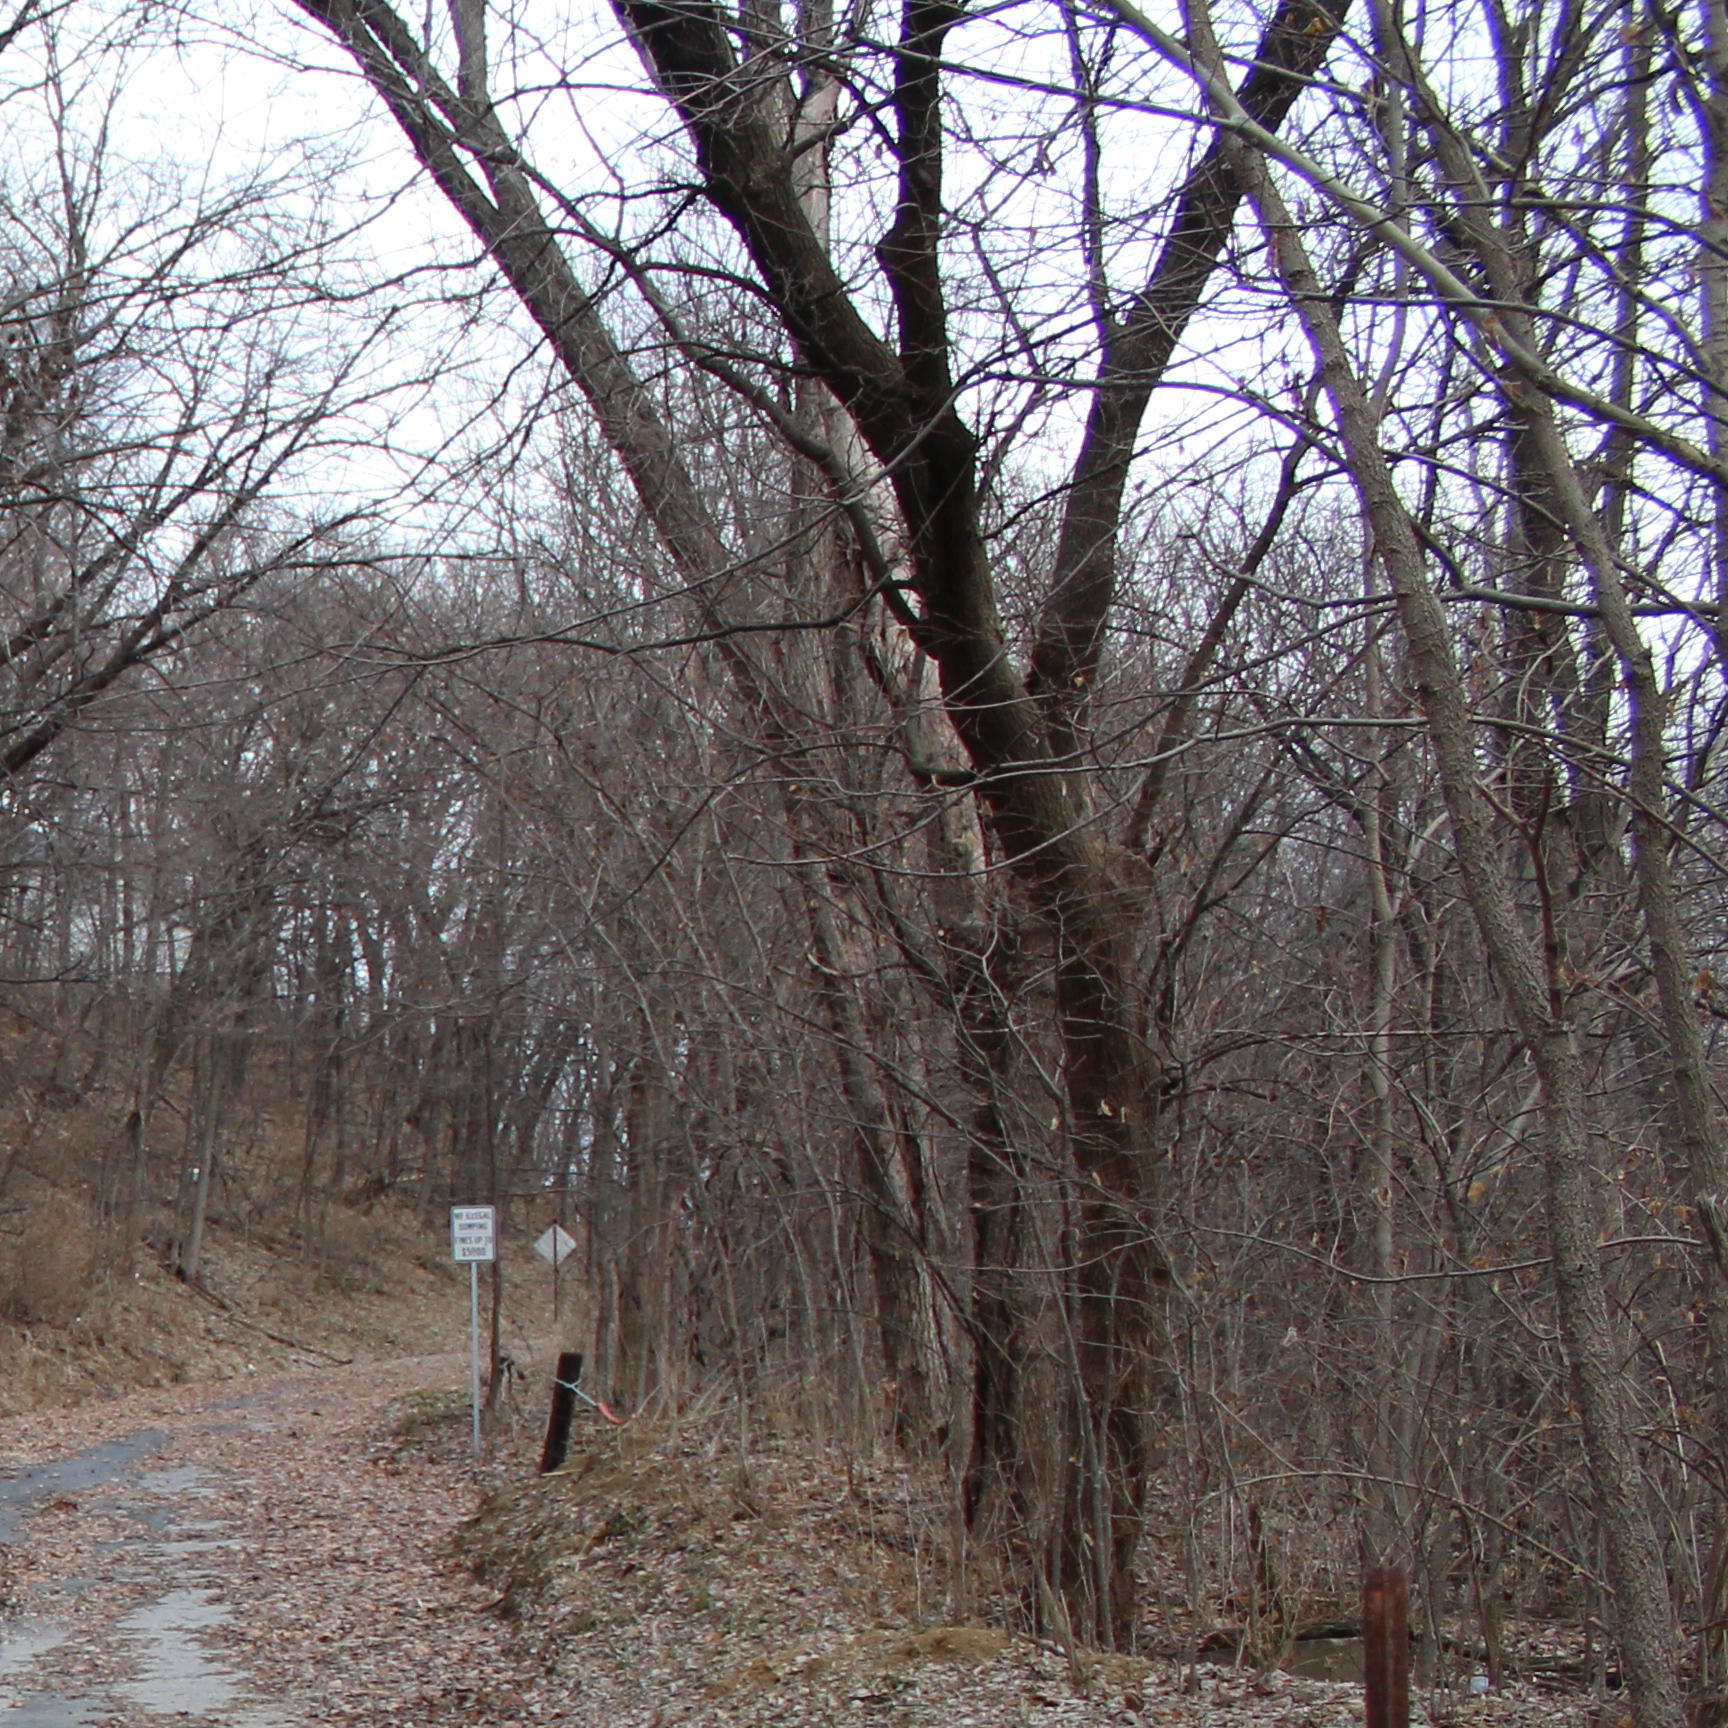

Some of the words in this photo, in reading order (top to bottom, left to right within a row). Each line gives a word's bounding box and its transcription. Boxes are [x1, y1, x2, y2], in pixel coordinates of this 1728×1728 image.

[454, 1212, 464, 1220] NO
[465, 1211, 492, 1220] ILLEGAL
[458, 1223, 488, 1231] DUMPING
[474, 1236, 484, 1245] UP
